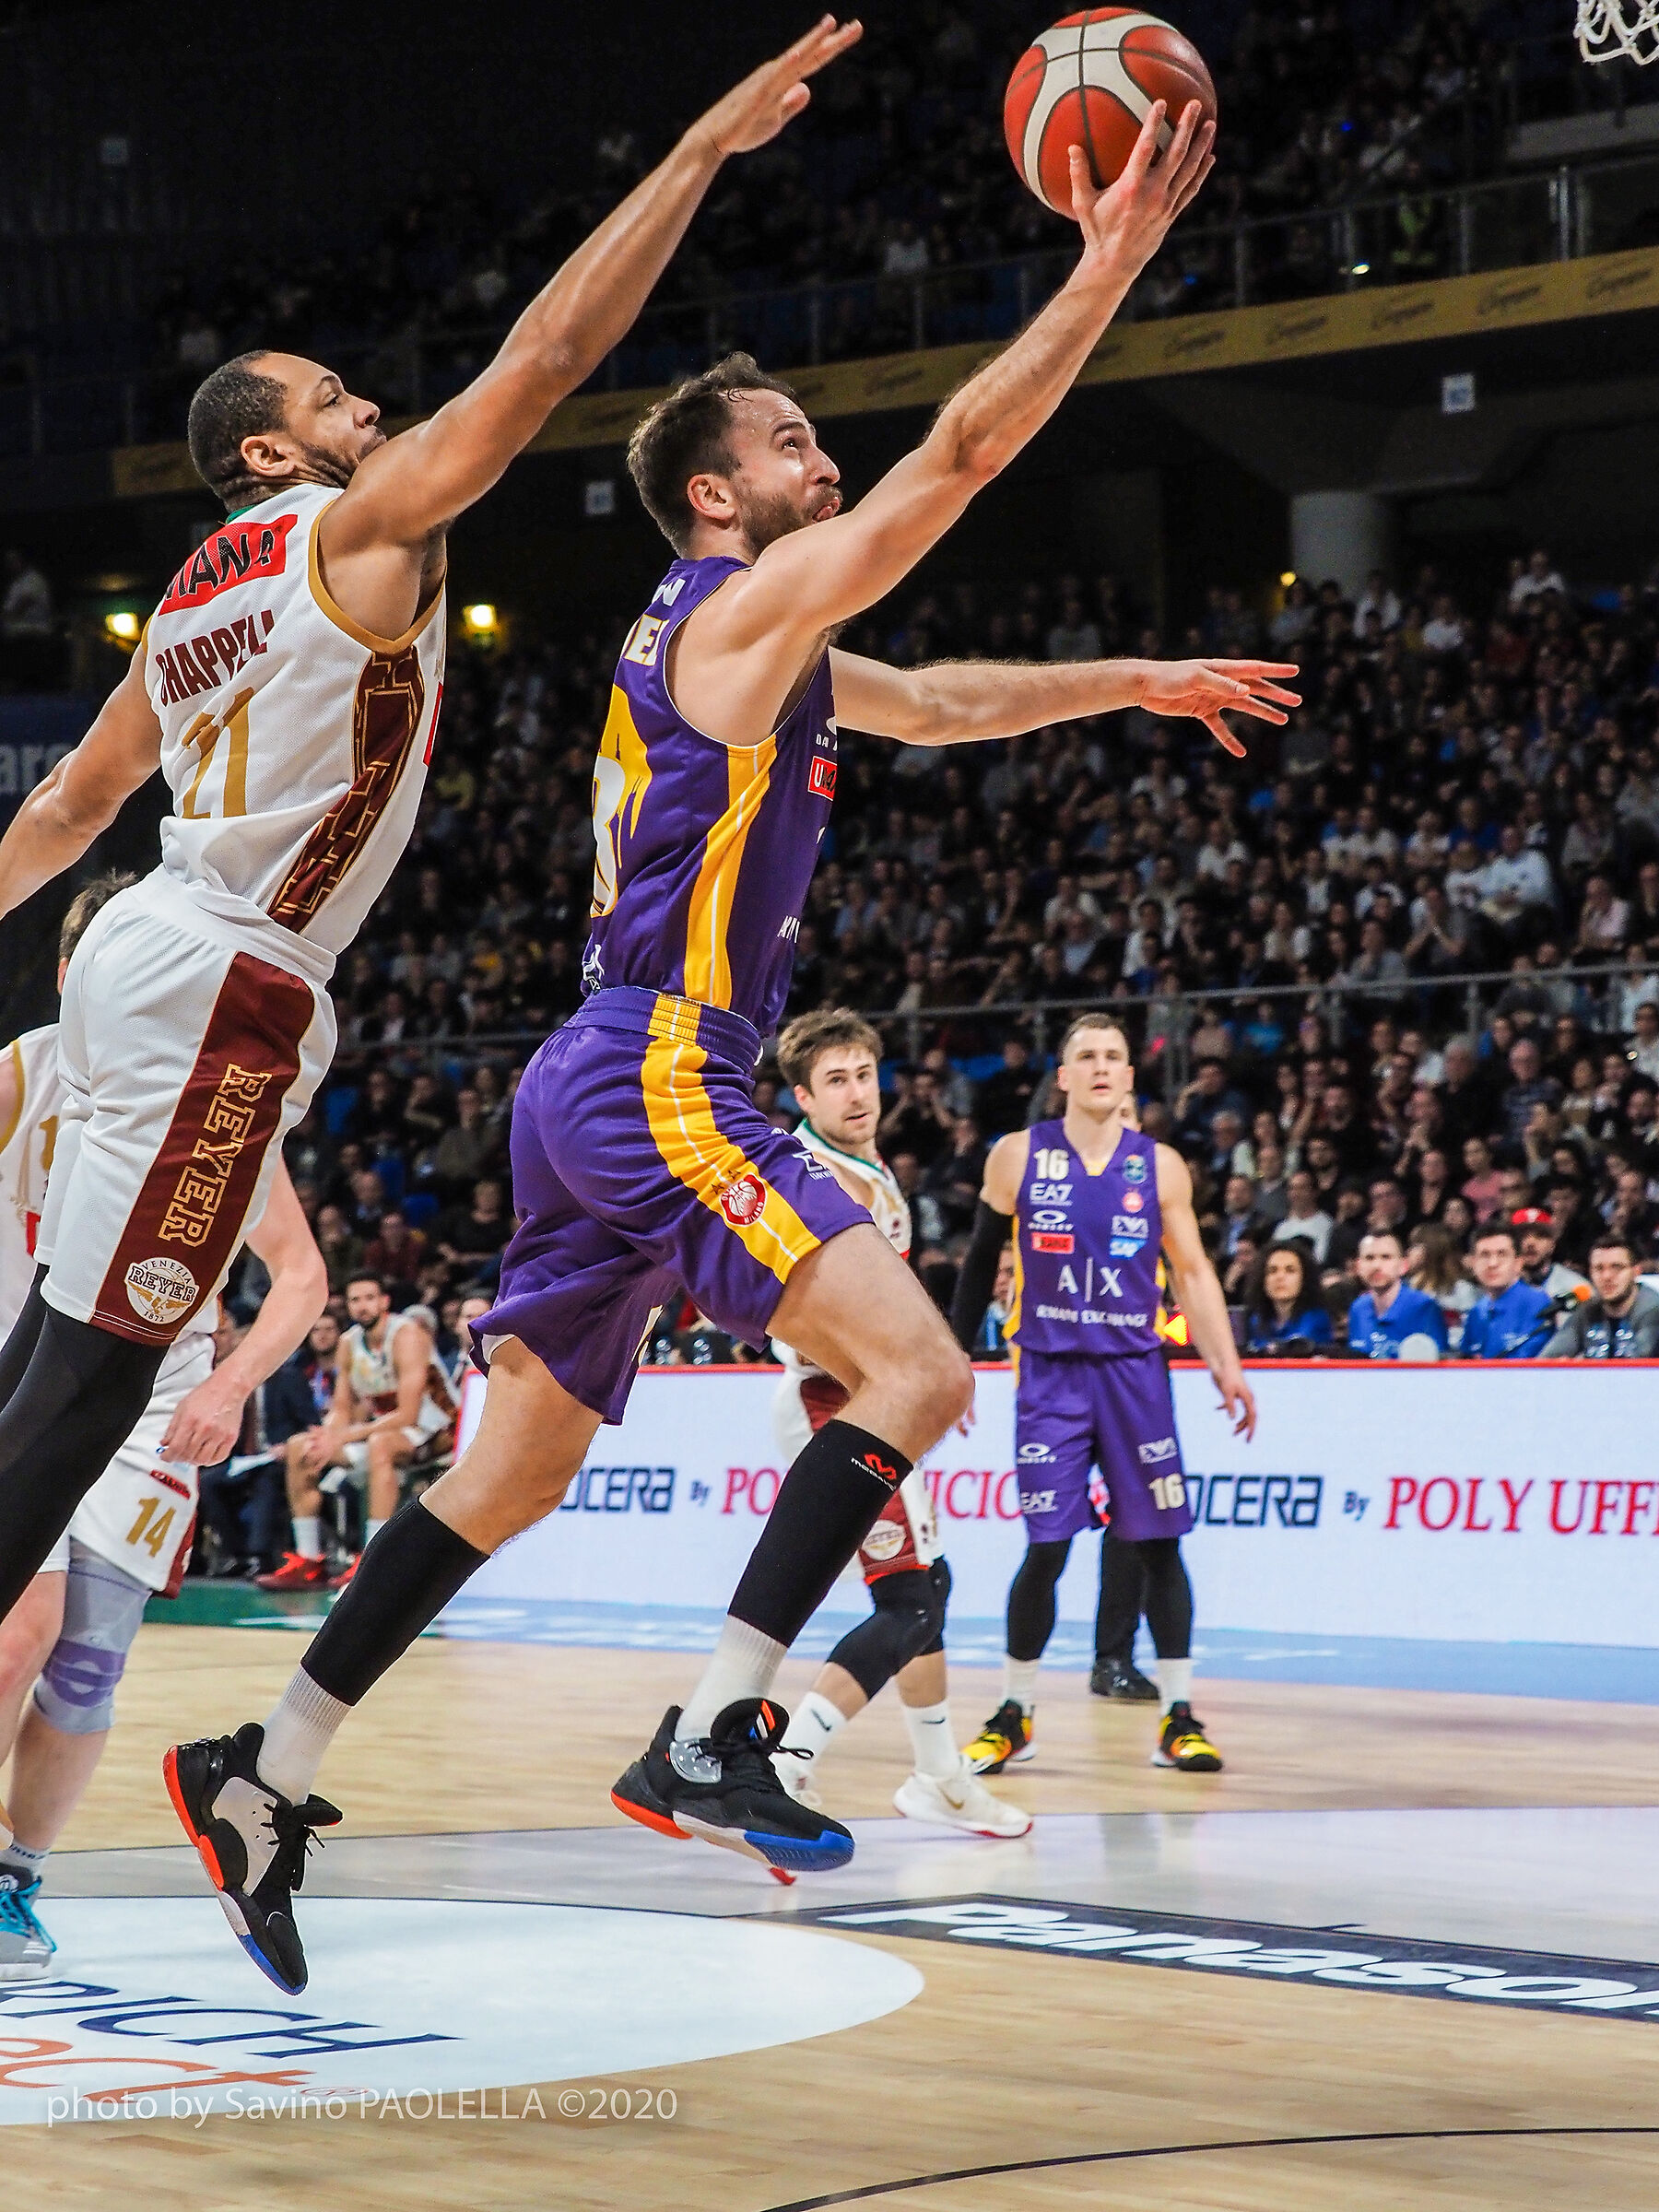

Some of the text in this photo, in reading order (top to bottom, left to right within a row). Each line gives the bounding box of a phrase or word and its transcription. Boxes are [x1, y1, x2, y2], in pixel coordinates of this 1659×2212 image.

[159, 1064, 272, 1248] REYER
[1033, 1147, 1070, 1181] 16
[1030, 1182, 1075, 1206] EA7
[127, 1265, 197, 1303] REYER
[141, 1260, 192, 1285] VENEZIA
[143, 1311, 165, 1323] 1872
[721, 1467, 789, 1516] PO
[1147, 1473, 1186, 1511] 16
[1343, 1490, 1371, 1522] By
[1382, 1477, 1535, 1533] POLY
[125, 1497, 177, 1559] 14
